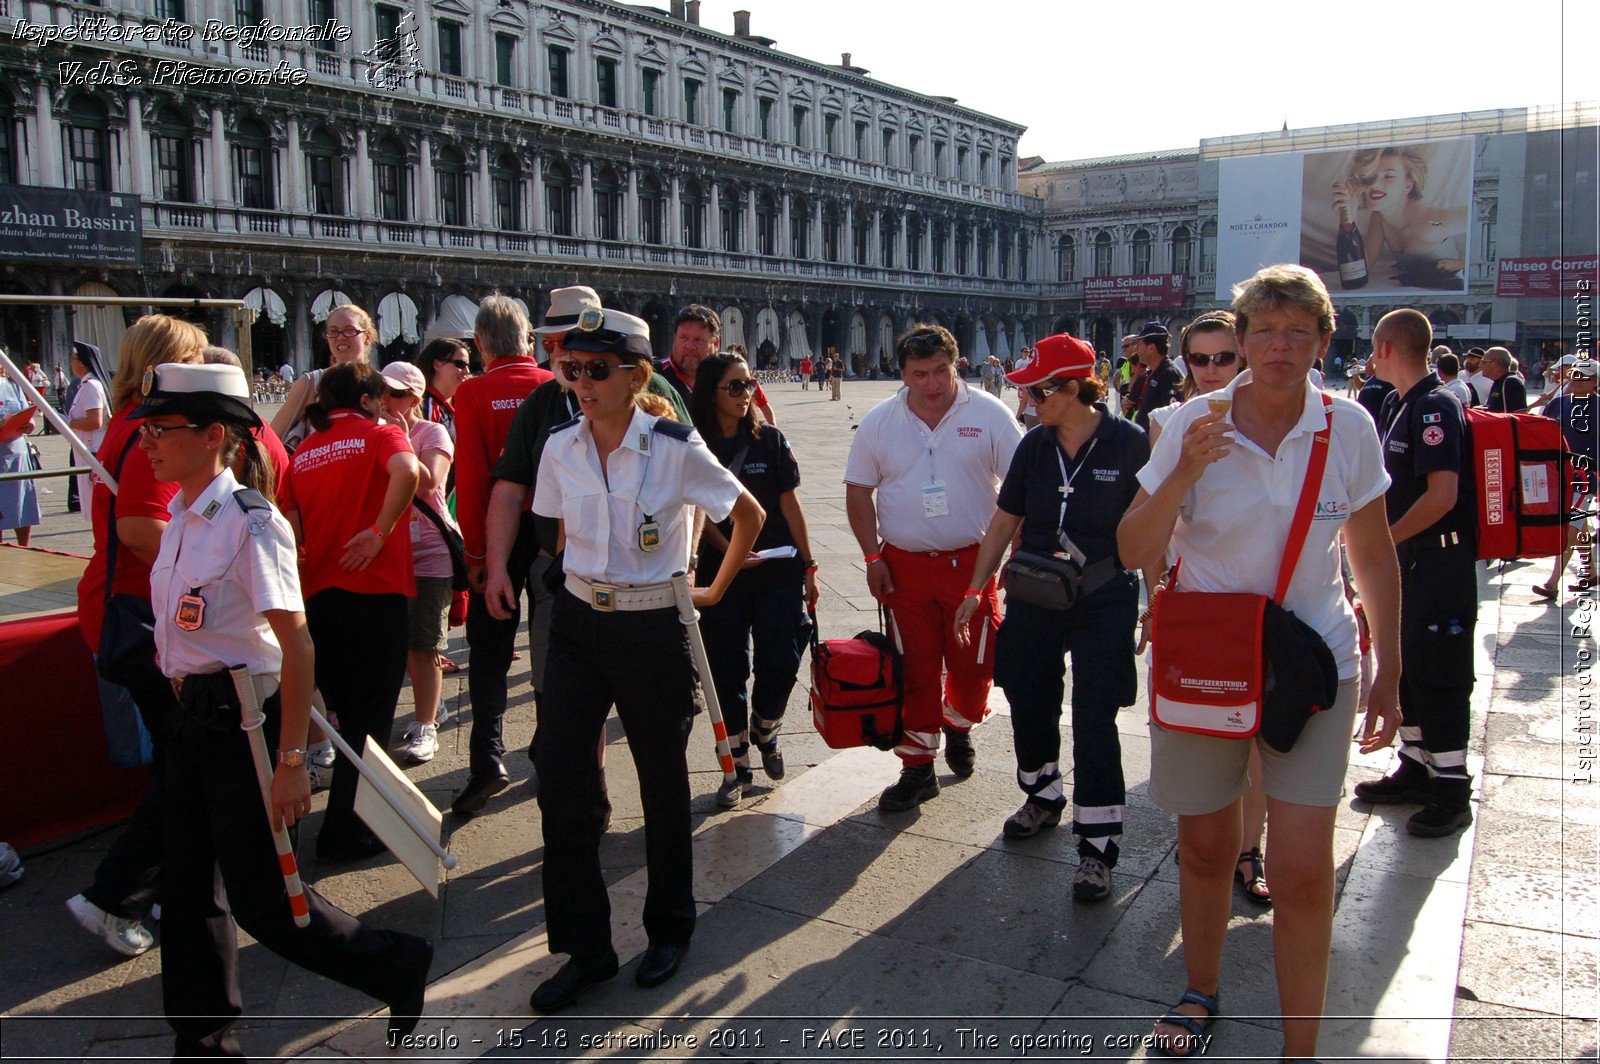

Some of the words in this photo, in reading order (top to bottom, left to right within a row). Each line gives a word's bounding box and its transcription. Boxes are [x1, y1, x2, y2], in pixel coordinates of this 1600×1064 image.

[64, 208, 136, 232] Bassiri
[26, 228, 47, 238] delle
[48, 231, 88, 240] meteoriti
[98, 244, 119, 252] Bruno
[1502, 260, 1548, 272] Museo
[1551, 259, 1597, 270] Correr
[1084, 279, 1114, 288] Julian
[1116, 276, 1163, 287] Schnabel
[492, 398, 516, 410] CROCE
[309, 444, 330, 460] ROSSA
[332, 438, 366, 452] ITALIANA
[1486, 450, 1500, 486] RESCUE
[1488, 491, 1501, 512] BAG
